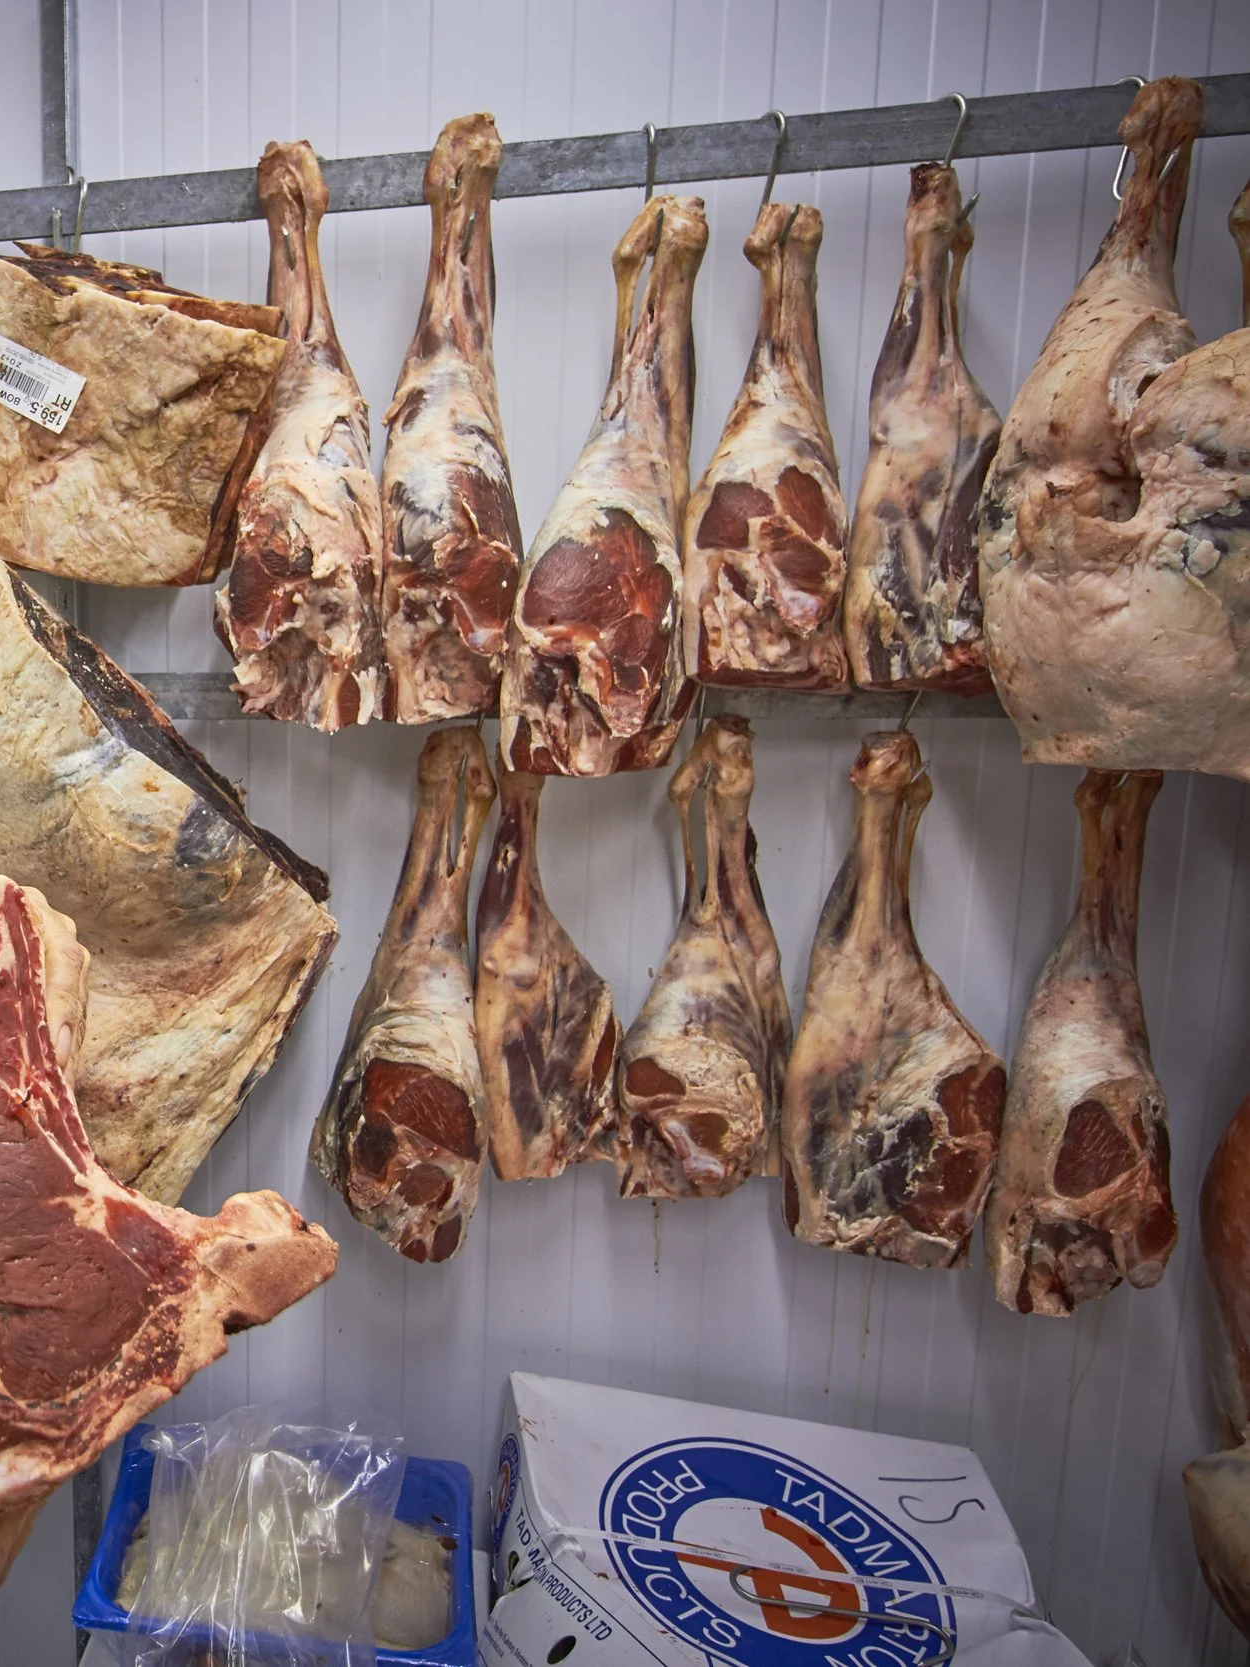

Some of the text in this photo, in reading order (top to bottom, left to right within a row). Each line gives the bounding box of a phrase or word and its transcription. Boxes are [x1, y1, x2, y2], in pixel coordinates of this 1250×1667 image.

[30, 401, 63, 427] 159.5
[52, 393, 73, 412] RT
[622, 1459, 742, 1648] PRODUCTS
[544, 1570, 593, 1624] PRODUCTS
[584, 1612, 613, 1641] LTD
